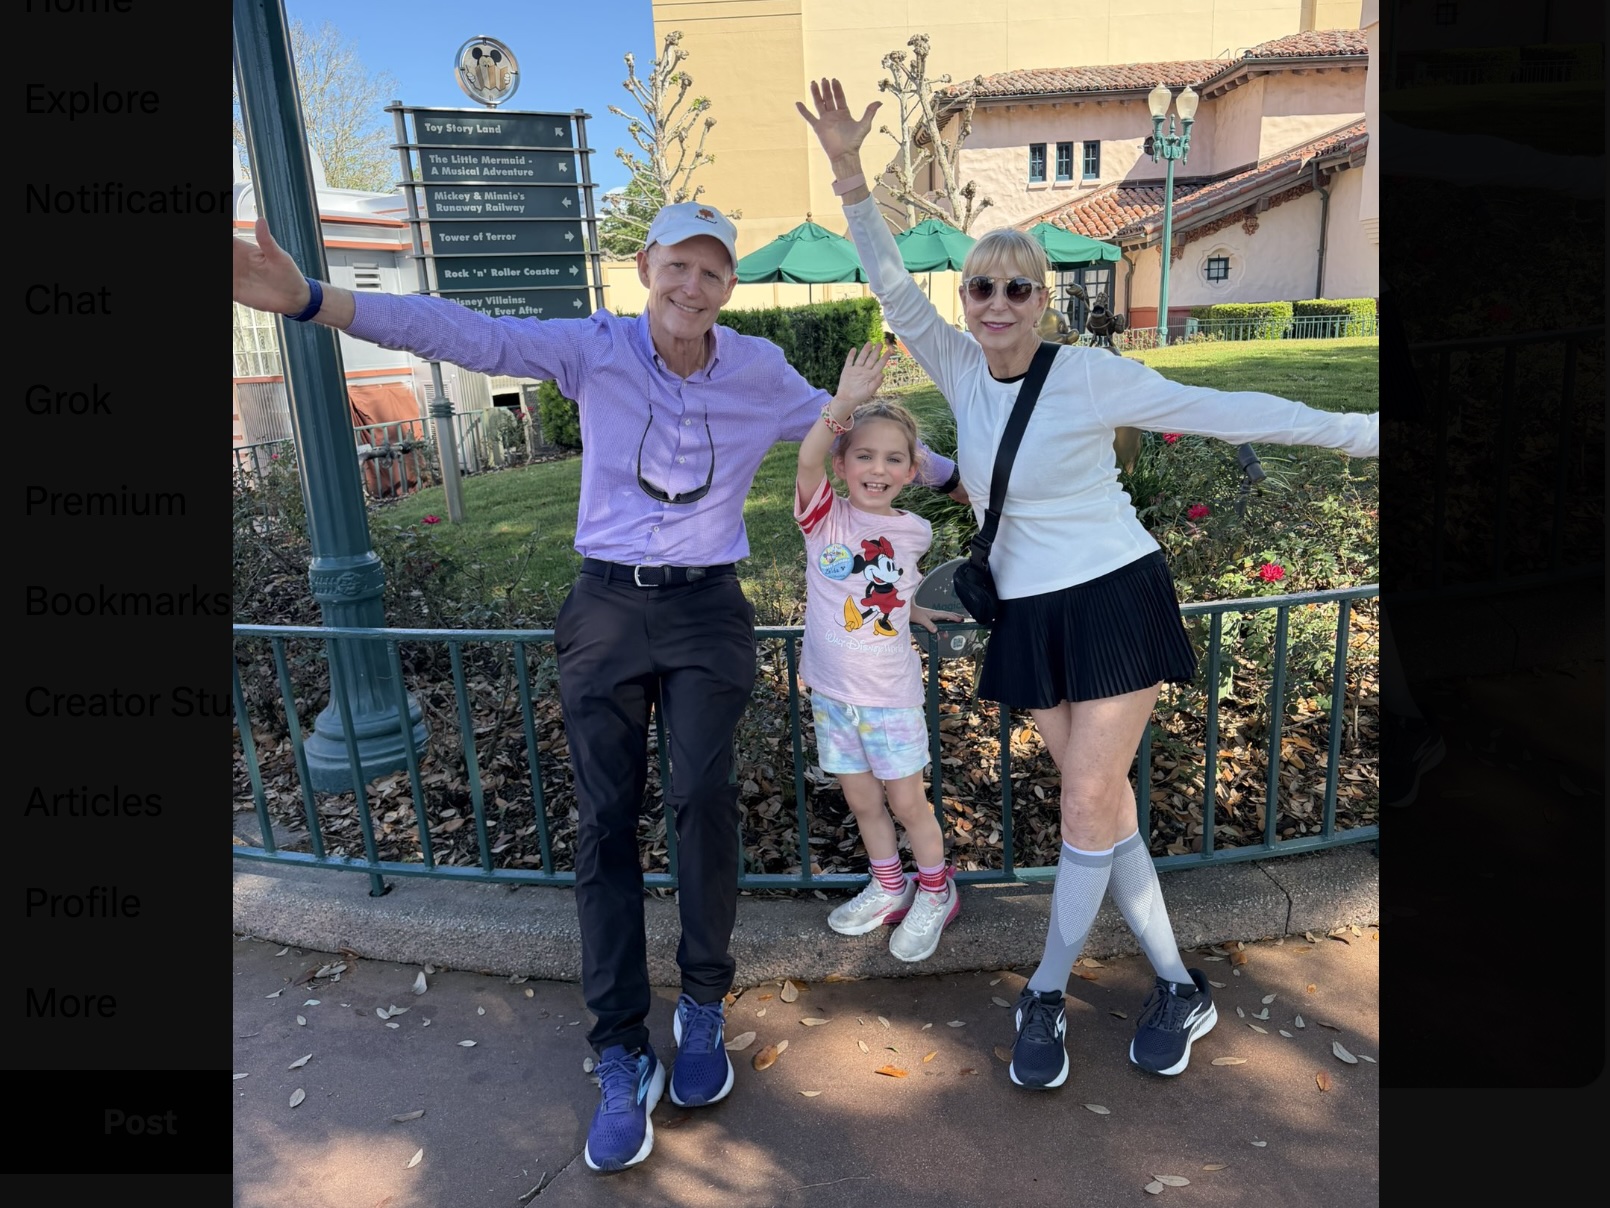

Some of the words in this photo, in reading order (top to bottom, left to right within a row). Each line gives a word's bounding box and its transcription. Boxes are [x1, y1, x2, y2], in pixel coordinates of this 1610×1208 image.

[424, 123, 443, 134] Toy
[446, 123, 473, 135] Story
[476, 124, 502, 134] Land
[429, 154, 448, 164] The
[451, 155, 478, 164] Little
[481, 155, 526, 165] Mermaid
[431, 167, 439, 175] A
[442, 167, 480, 176] Musical
[482, 167, 534, 176] Adventure
[434, 191, 471, 202] Mickey
[473, 192, 482, 200] &
[484, 191, 525, 200] Minnie's
[435, 203, 483, 213] Runaway
[485, 203, 525, 214] Railway
[439, 233, 470, 242] Tower
[473, 232, 483, 241] of
[486, 232, 516, 241] Terror
[444, 269, 470, 278] Rock
[491, 267, 521, 277] Roller
[524, 267, 560, 276] Coaster
[485, 295, 526, 305] Villains:
[494, 307, 516, 316] Ever
[518, 306, 543, 315] After
